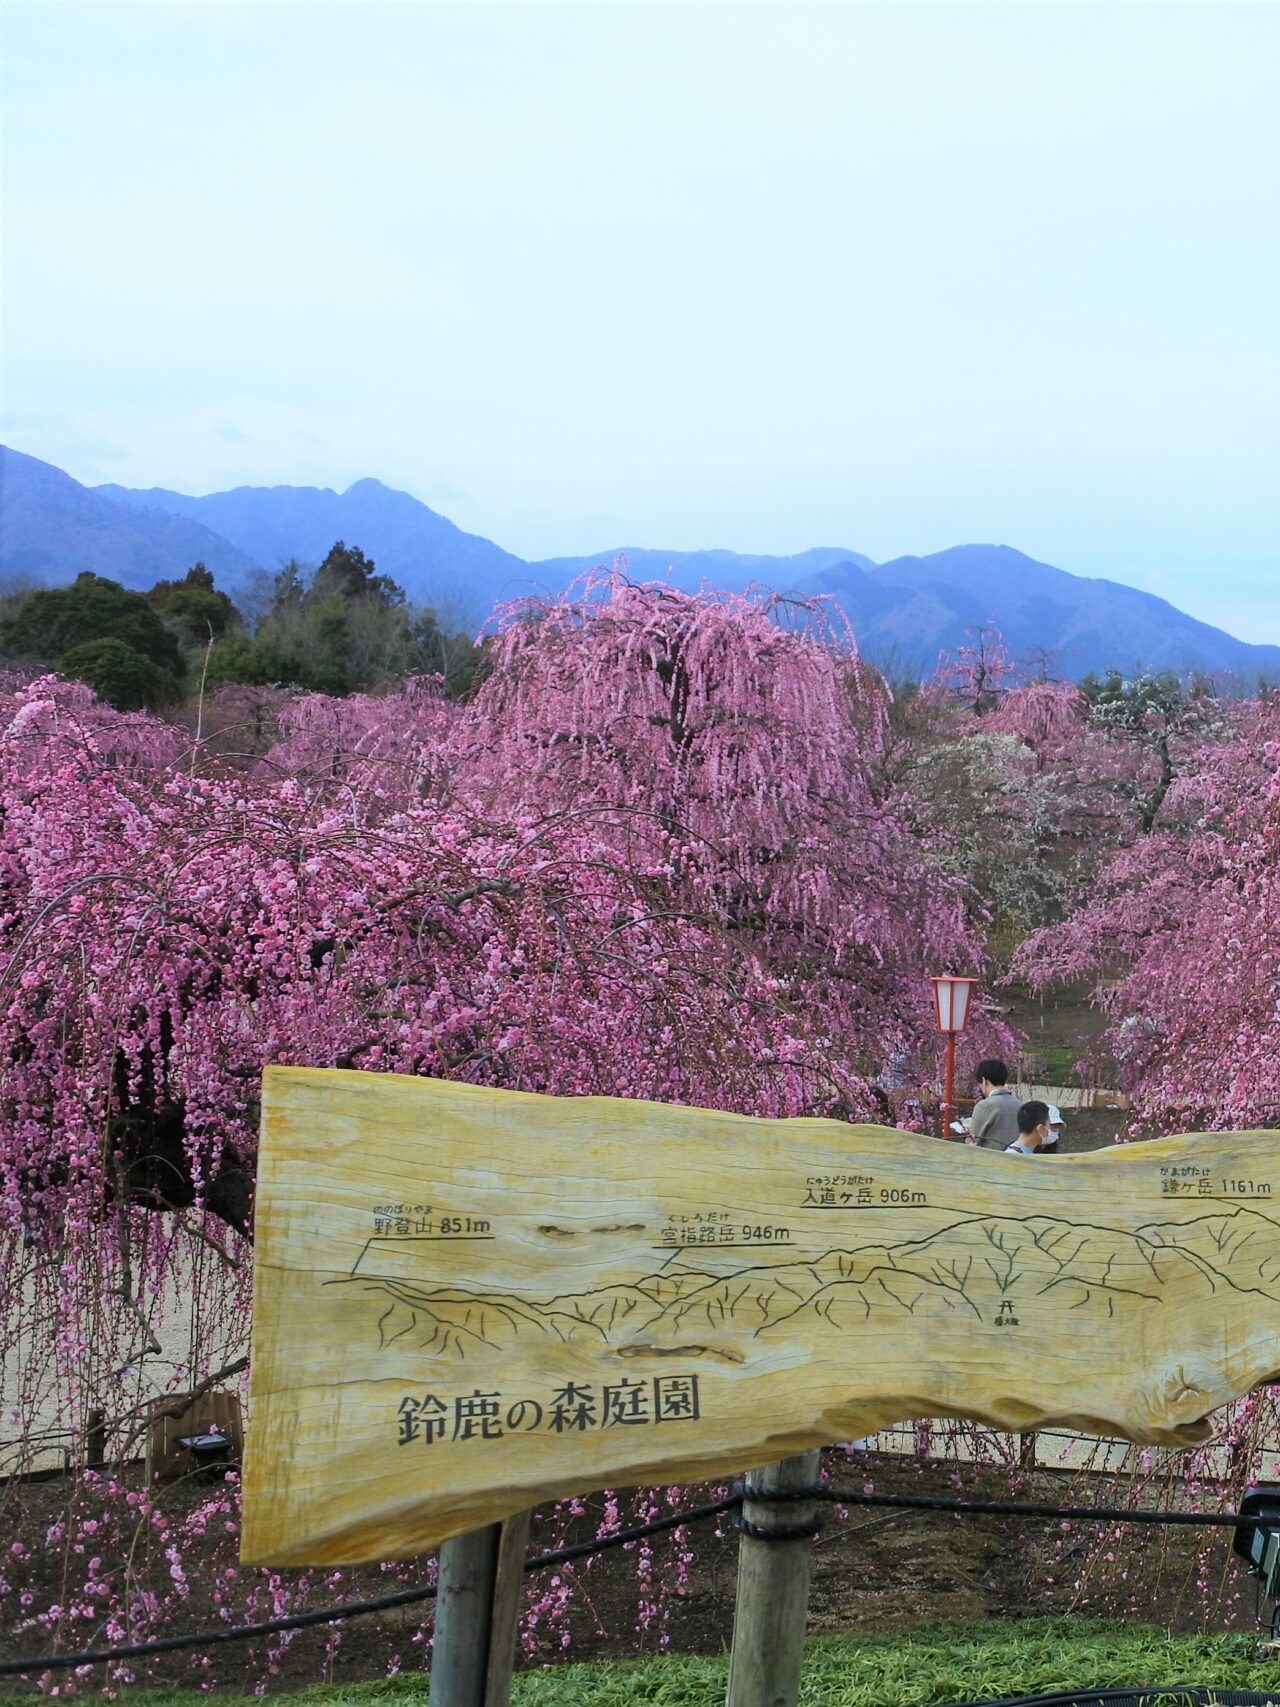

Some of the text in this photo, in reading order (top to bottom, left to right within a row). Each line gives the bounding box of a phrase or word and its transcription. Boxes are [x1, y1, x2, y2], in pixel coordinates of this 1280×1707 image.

[1160, 1167, 1212, 1177] かまがたけ
[806, 1175, 874, 1186] にゅうどうがたけ
[1222, 1179, 1272, 1194] 1161m
[880, 1188, 927, 1204] 906m
[668, 1211, 730, 1223] くしろだけ
[374, 1216, 491, 1236] 野登山 851m
[661, 1225, 790, 1245] 宮指路岳 946m
[397, 1374, 700, 1446] 鈴鹿の森庭園
